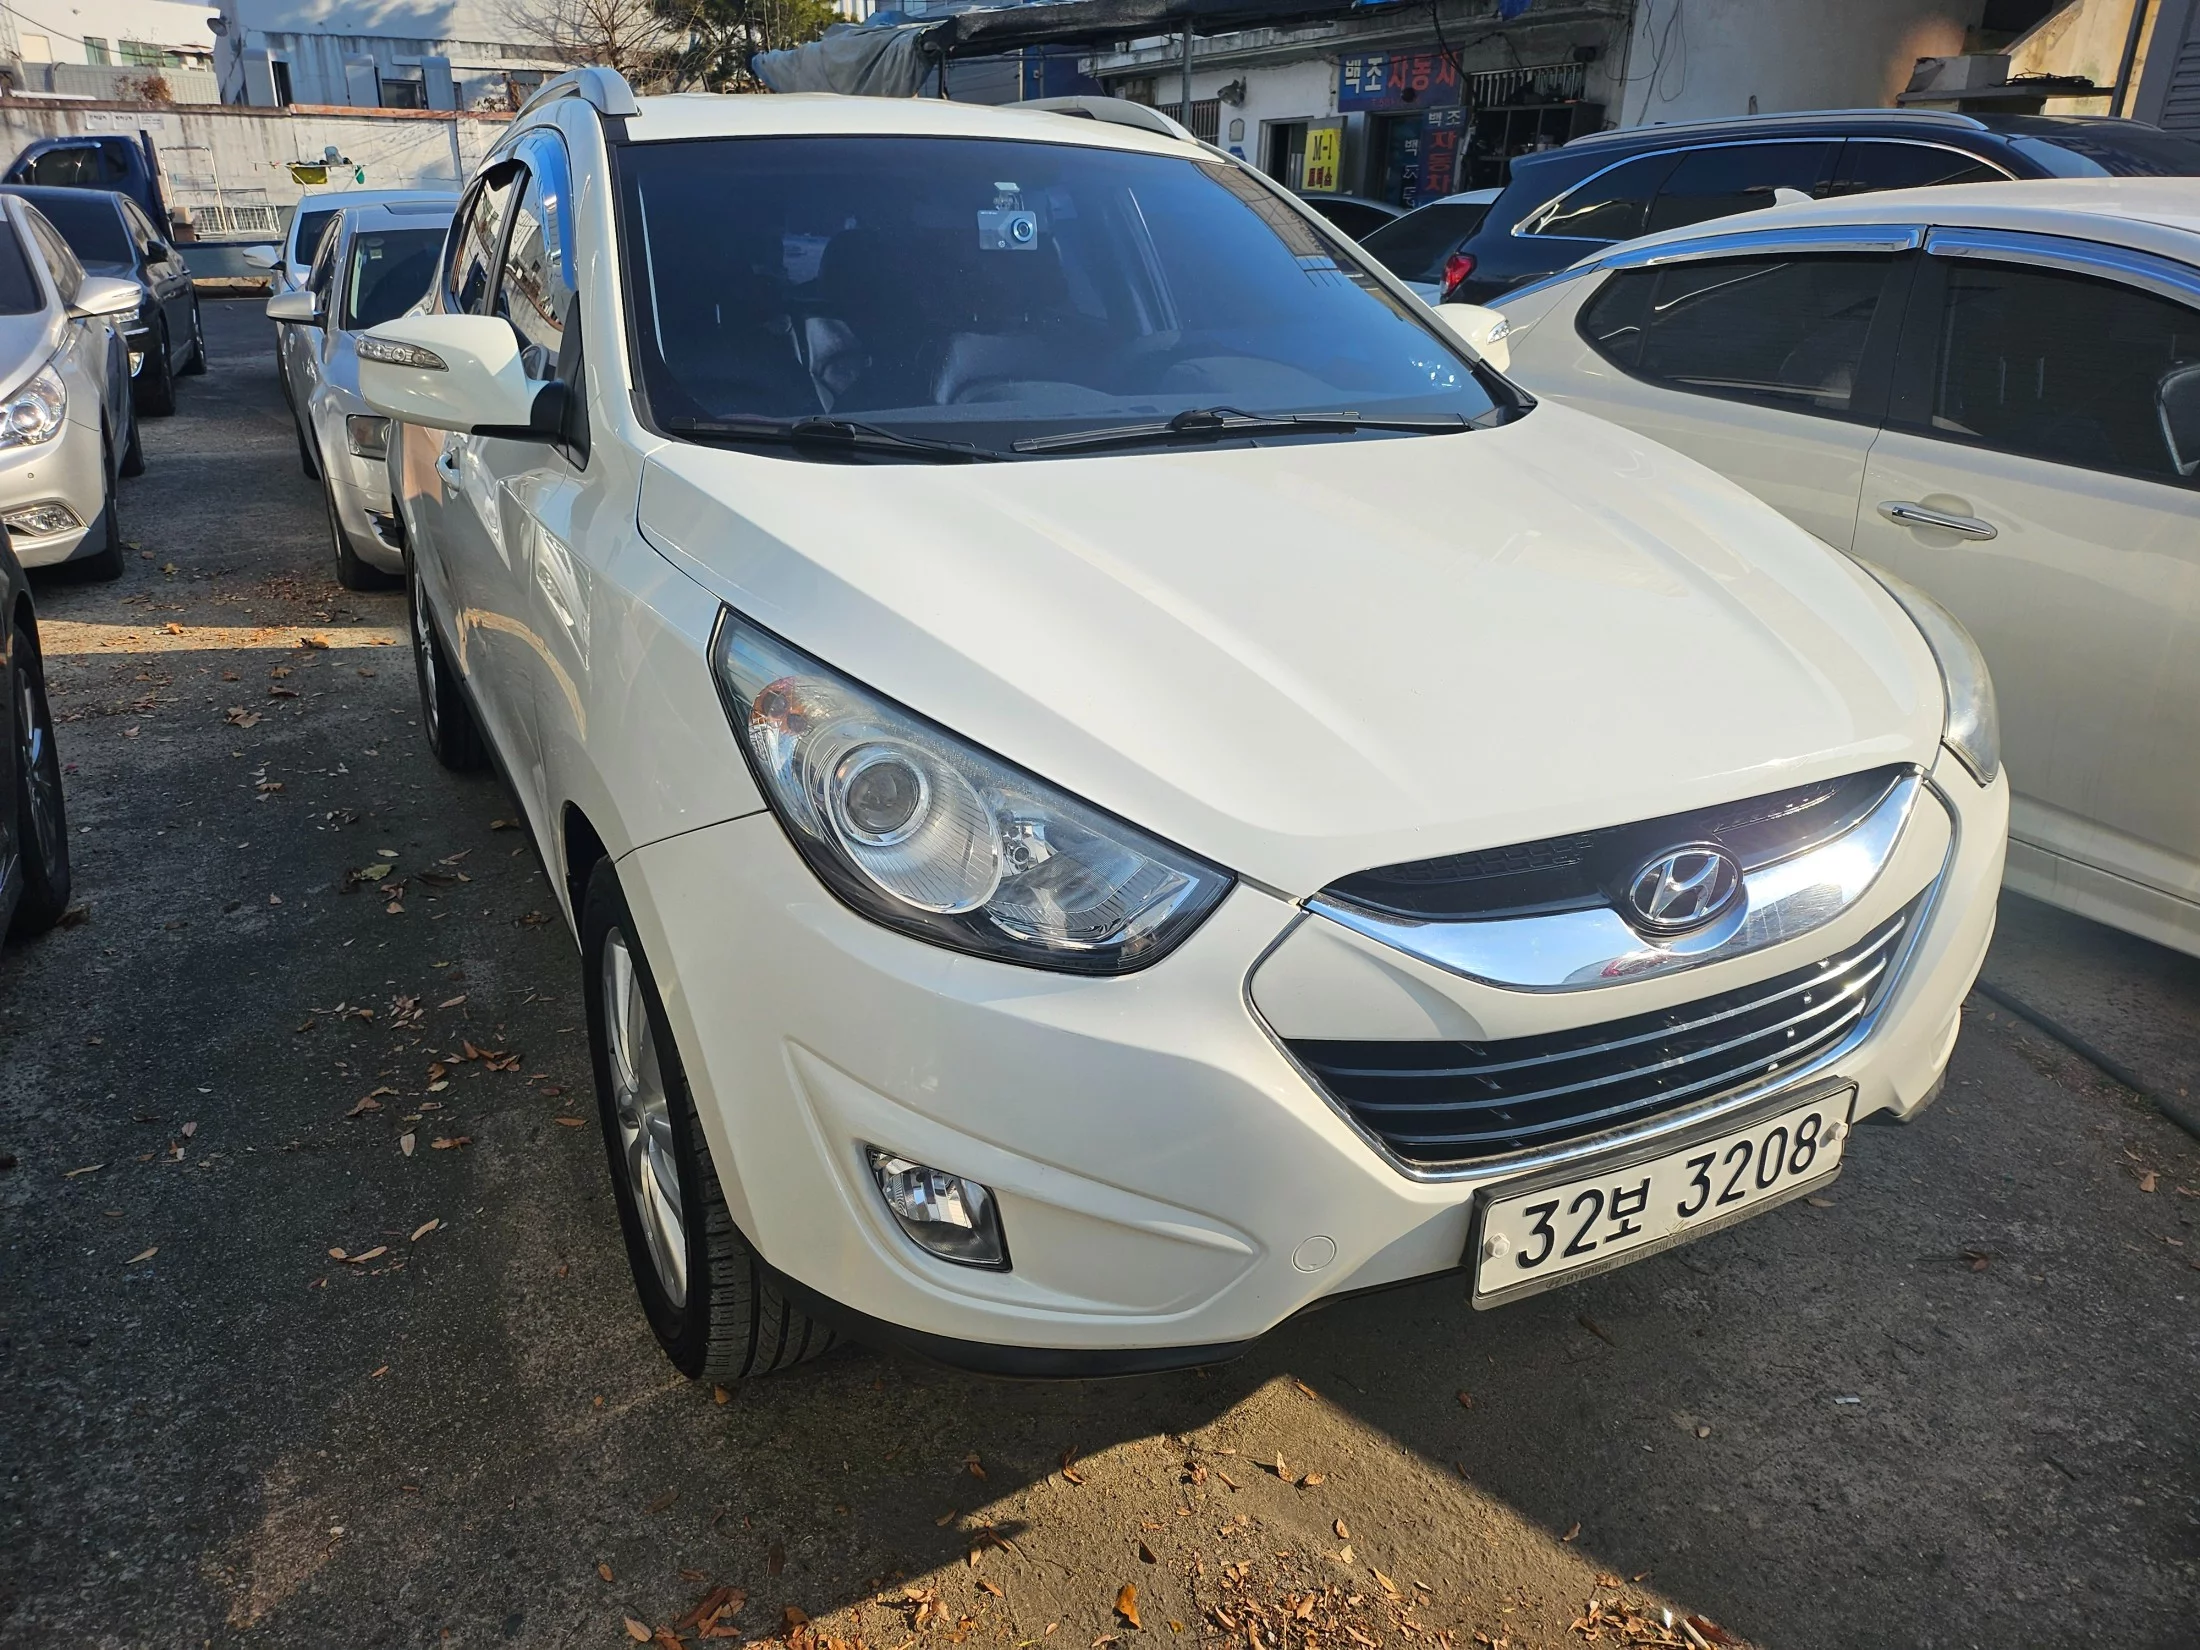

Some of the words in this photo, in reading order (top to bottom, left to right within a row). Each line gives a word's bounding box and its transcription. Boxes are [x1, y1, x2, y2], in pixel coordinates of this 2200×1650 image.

[1345, 57, 1382, 94] 백조
[1428, 110, 1461, 127] 백조
[1517, 1177, 1650, 1269] 32보
[1677, 1112, 1822, 1219] 3208
